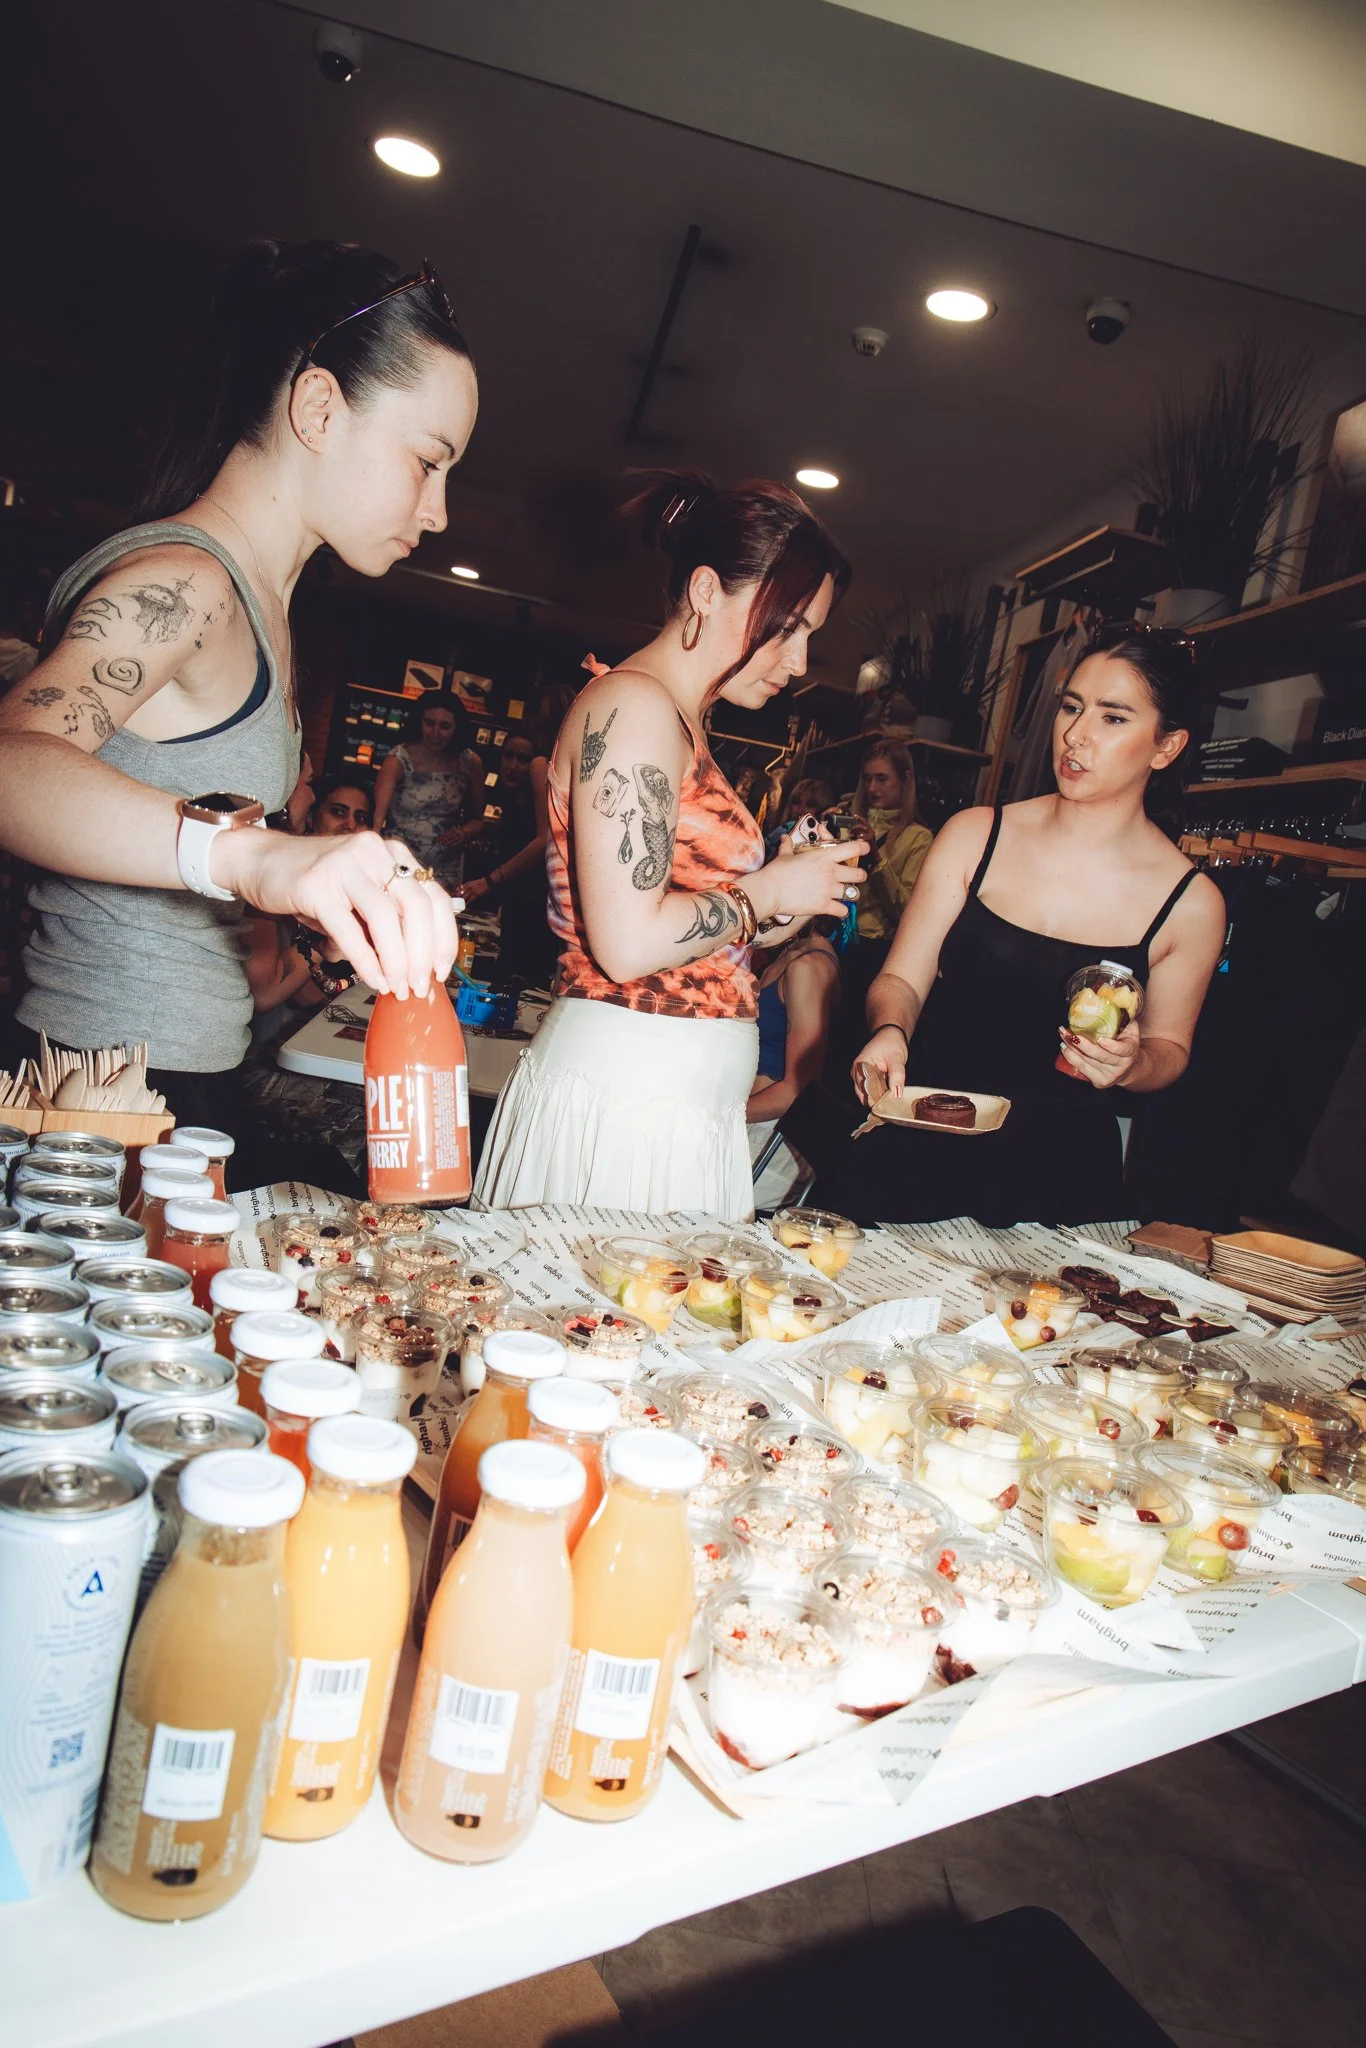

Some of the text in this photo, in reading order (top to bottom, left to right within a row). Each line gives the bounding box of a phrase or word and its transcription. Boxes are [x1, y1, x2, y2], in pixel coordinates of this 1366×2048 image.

[1323, 729, 1347, 744] Black
[288, 1181, 299, 1208] brigha
[259, 1237, 270, 1267] brigham
[462, 1236, 480, 1257] brigham
[775, 1249, 797, 1264] brigham
[1085, 1251, 1105, 1263] brigham
[543, 1263, 563, 1280] brigham
[1118, 1264, 1142, 1279] brigham
[515, 1288, 535, 1306] brigham
[574, 1287, 596, 1304] brigham
[1158, 1285, 1184, 1301] brigham
[1200, 1304, 1226, 1317] brigham
[653, 1343, 670, 1359] brig
[418, 1418, 433, 1455] righa
[1328, 1530, 1366, 1545] righam
[1186, 1608, 1239, 1618] brigham
[1077, 1608, 1130, 1652] brigham
[878, 1768, 916, 1781] brigh
